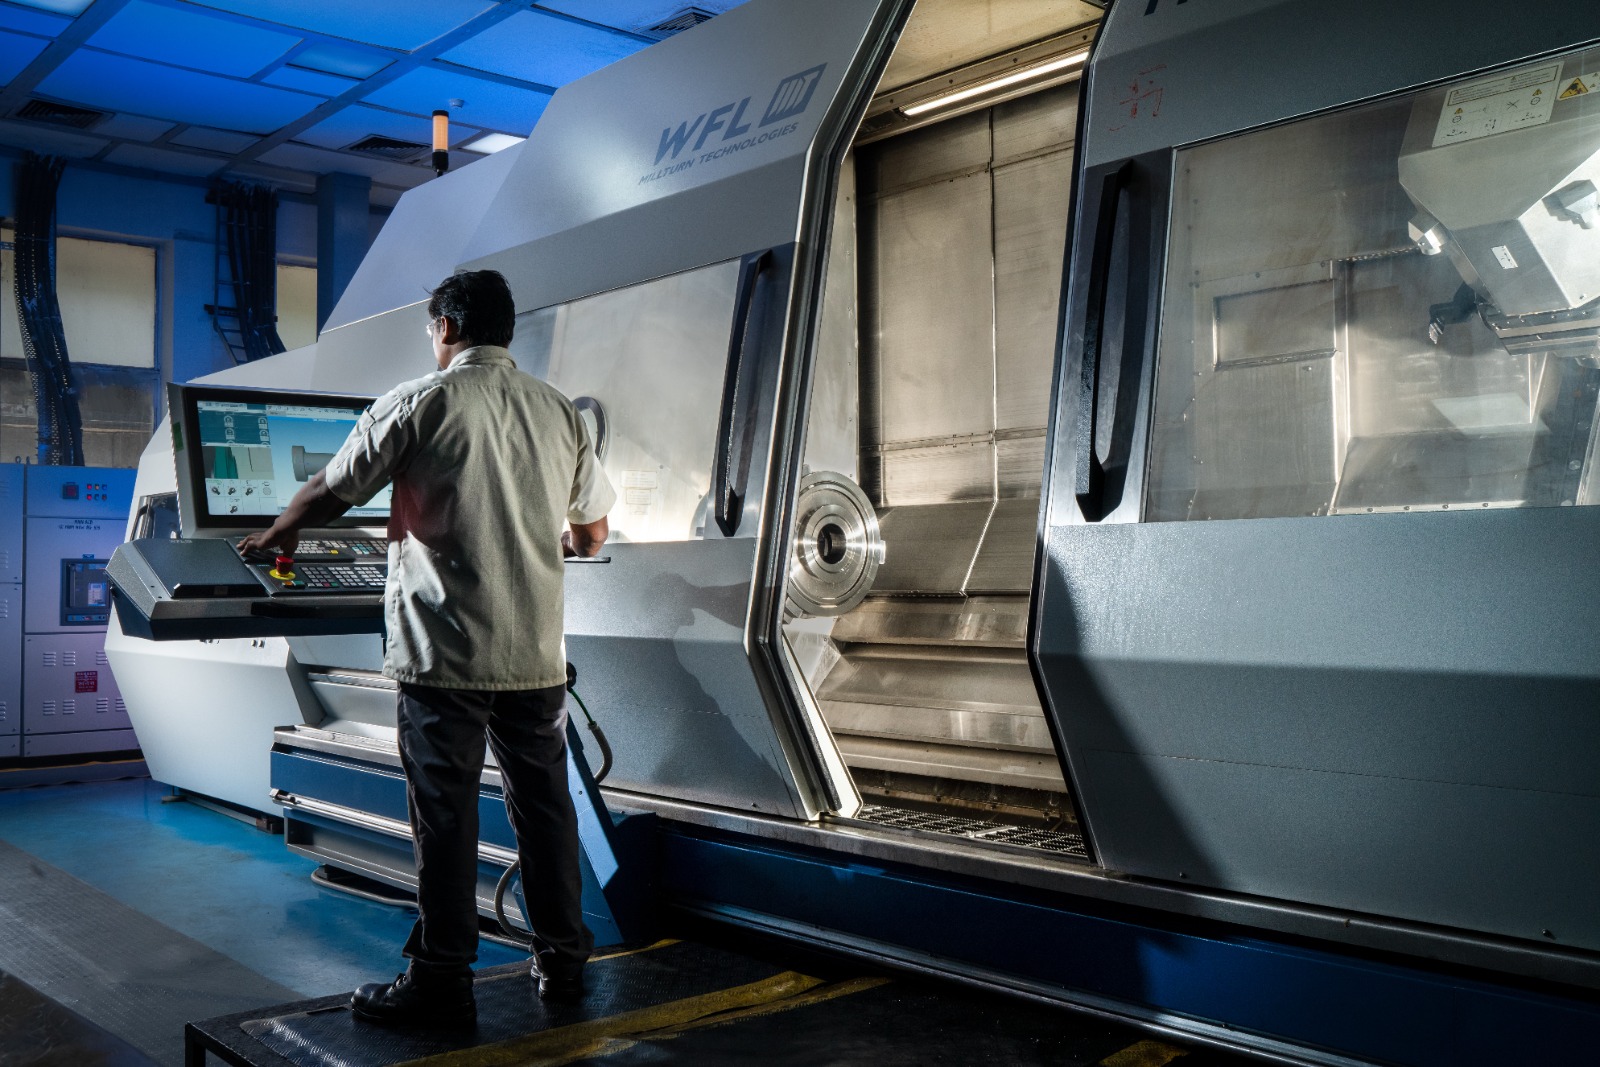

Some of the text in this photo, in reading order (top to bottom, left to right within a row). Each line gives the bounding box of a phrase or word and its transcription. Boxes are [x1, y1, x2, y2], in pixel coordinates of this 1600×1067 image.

[638, 122, 799, 185] MILLTURN TECHNOLOGIES
[654, 96, 752, 166] WFL
